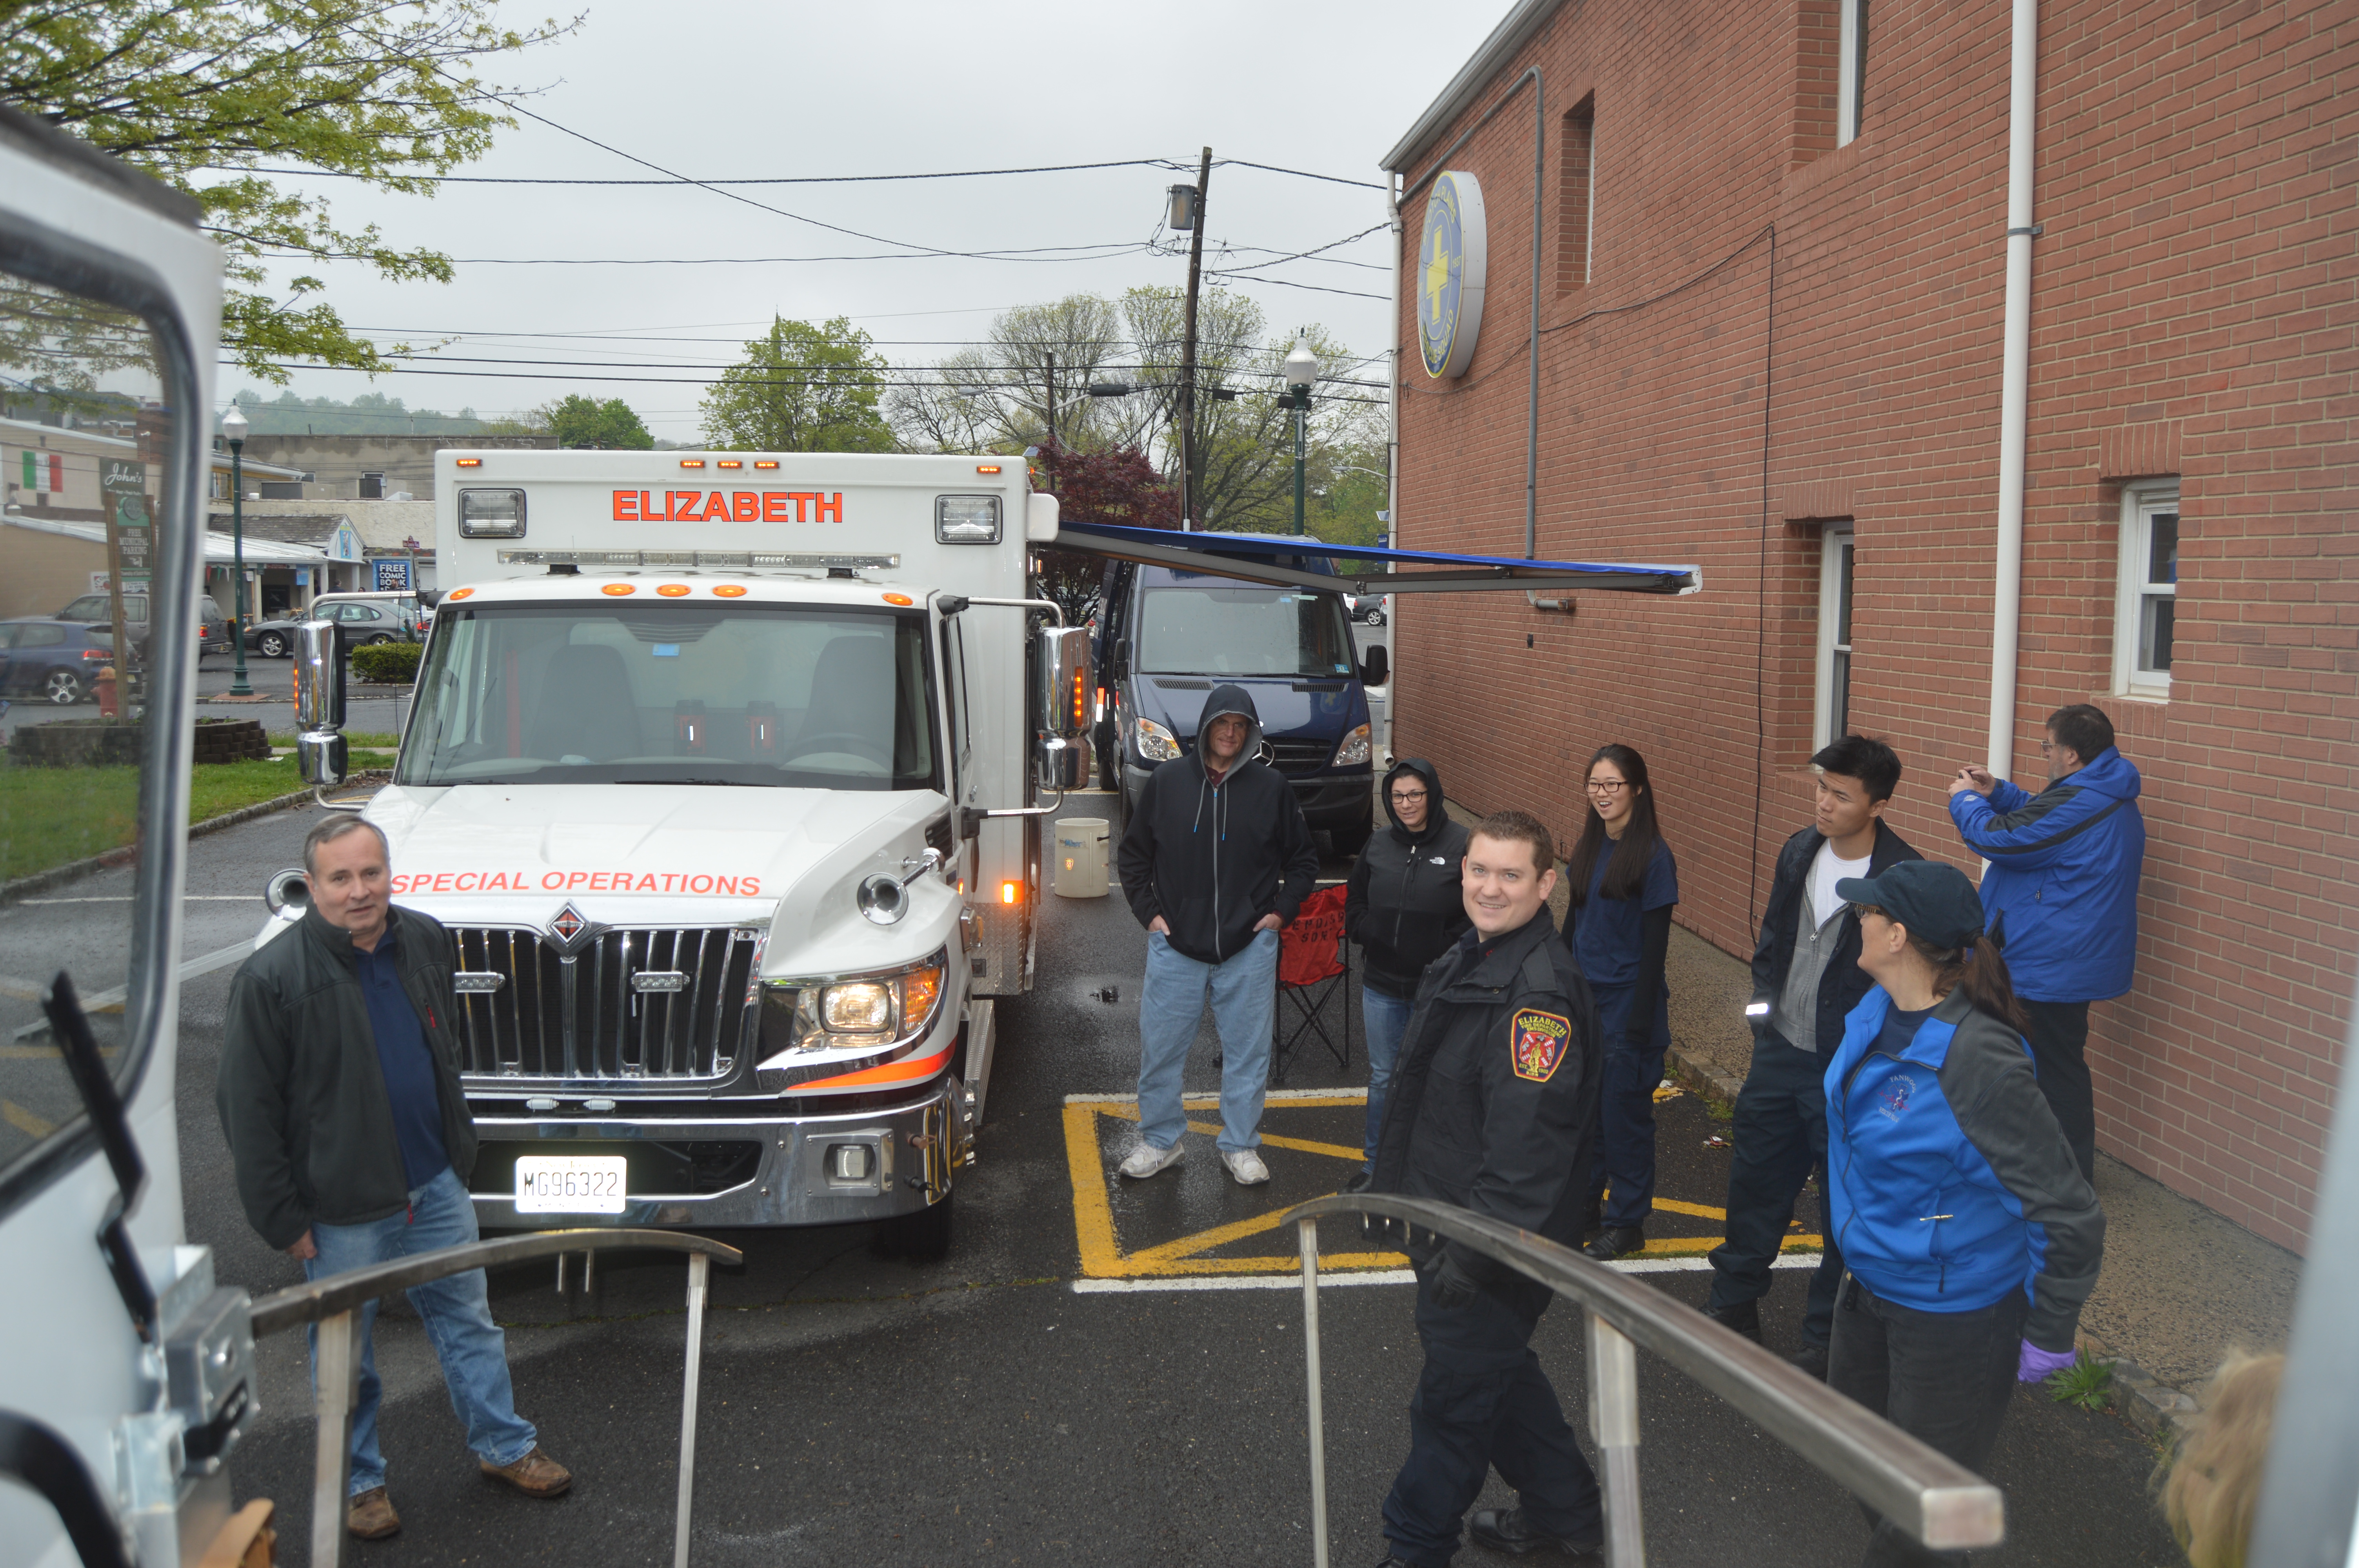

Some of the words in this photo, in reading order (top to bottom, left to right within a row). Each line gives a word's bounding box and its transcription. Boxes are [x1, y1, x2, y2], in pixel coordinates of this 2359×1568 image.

[1423, 187, 1441, 246] SCOTCH
[1441, 185, 1456, 224] PLAINS
[1452, 256, 1461, 269] 1937
[1423, 324, 1437, 364] RESCUE
[1438, 309, 1453, 360] SQUAD
[105, 463, 142, 485] John's
[613, 490, 842, 523] ELIZABETH
[119, 537, 149, 546] MUNICIPAL
[380, 564, 405, 572] FREE
[391, 871, 530, 894] SPECIAL
[541, 871, 761, 897] OPERATIONS
[1518, 1016, 1567, 1036] ELIZABETH
[1533, 1023, 1563, 1038] DEPARTMENT
[1538, 1027, 1556, 1038] DIVISION
[1889, 1075, 1916, 1093] FANWOOD
[525, 1172, 617, 1196] MG96322
